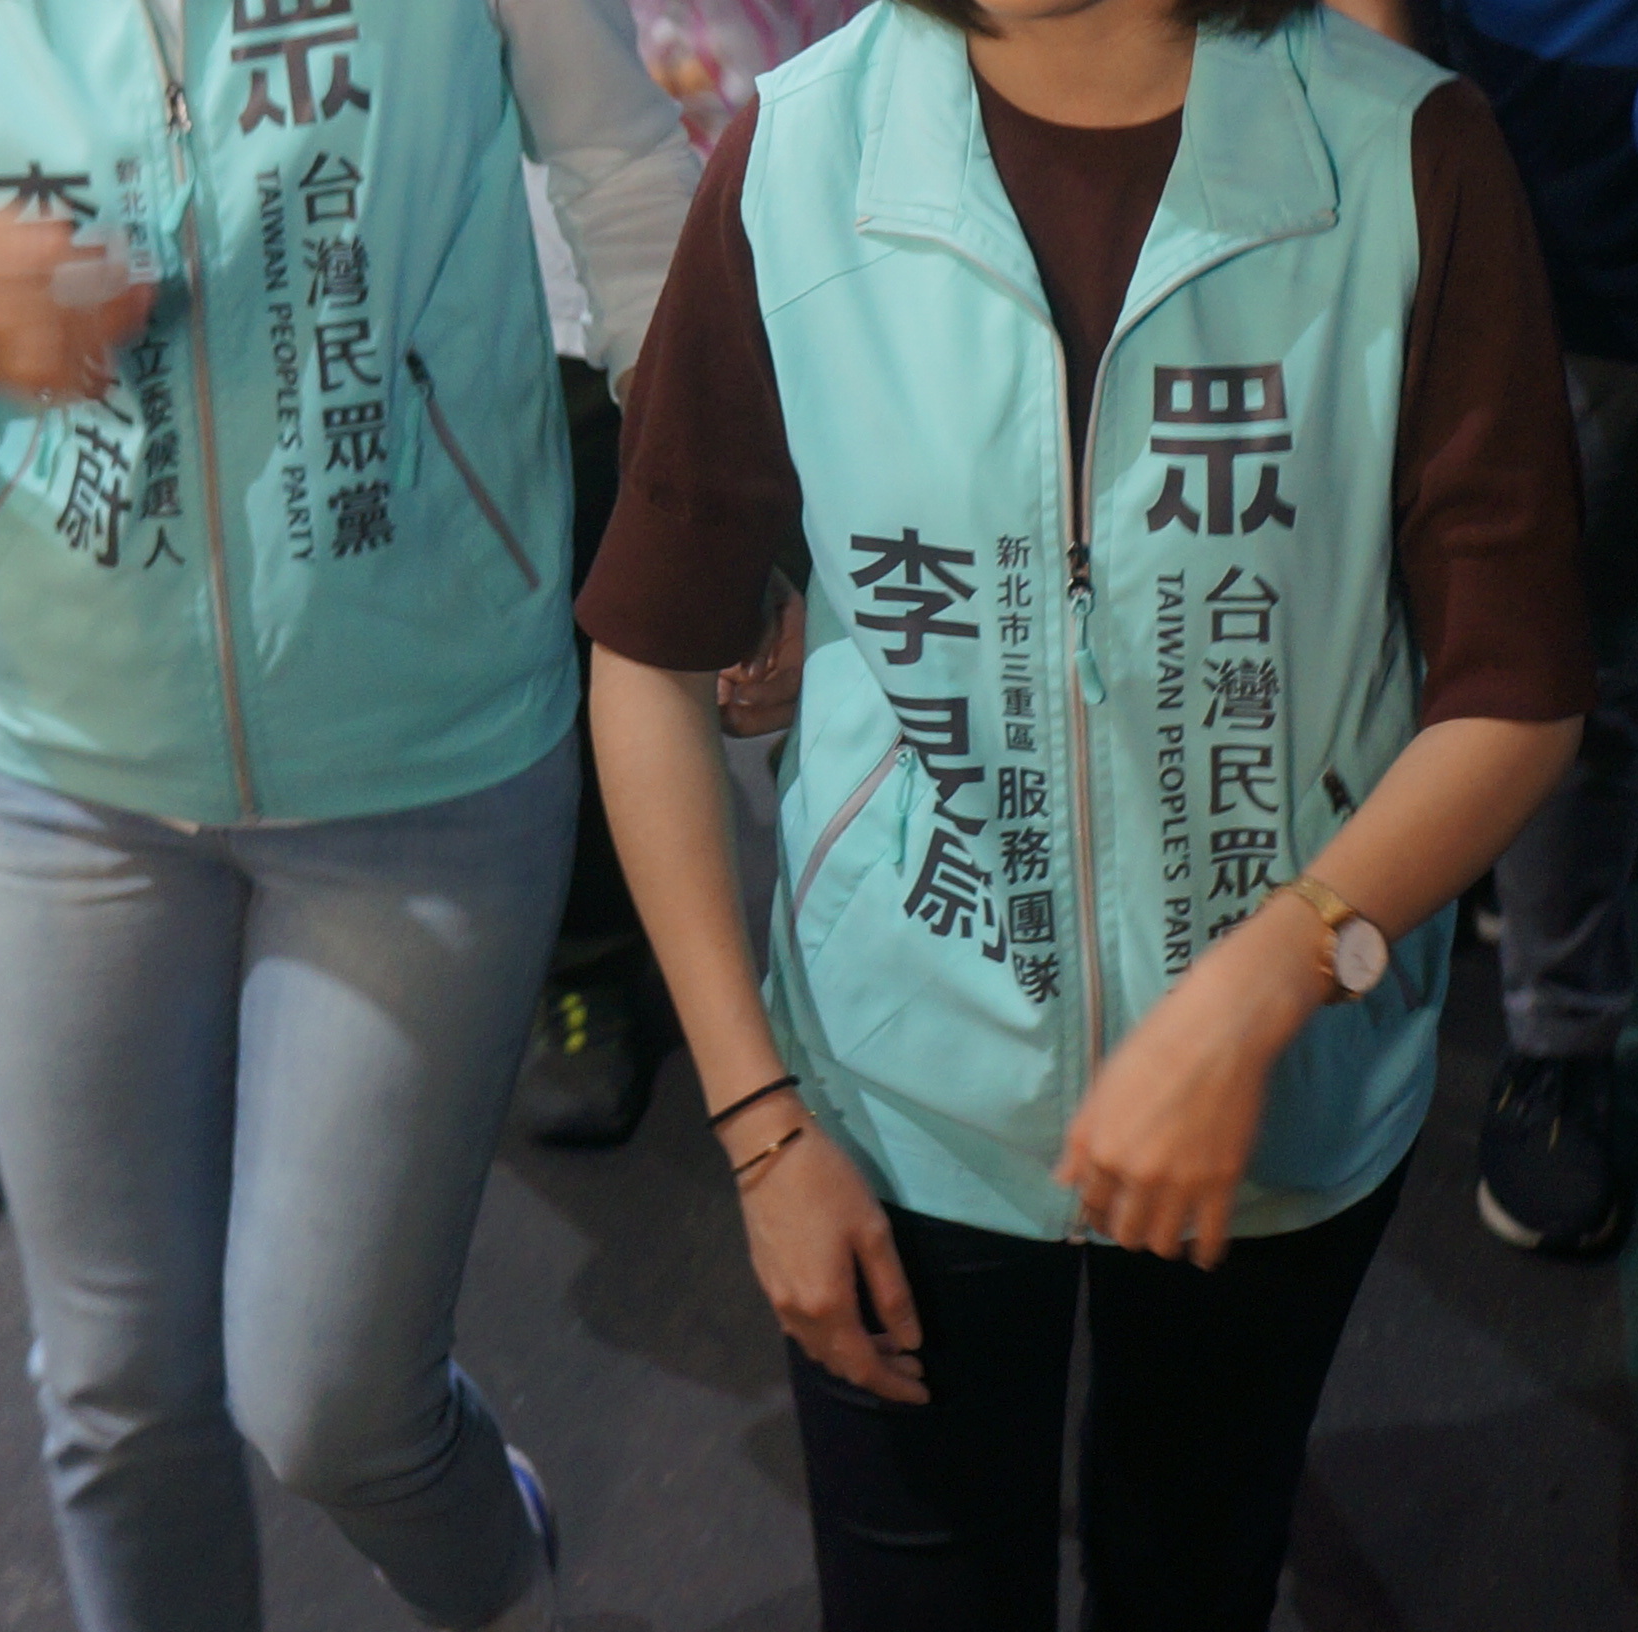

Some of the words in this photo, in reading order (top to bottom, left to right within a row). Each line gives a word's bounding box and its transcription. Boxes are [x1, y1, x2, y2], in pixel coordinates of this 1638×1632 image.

[256, 168, 289, 294] TAIWAN
[280, 464, 316, 563] PARTY
[297, 152, 395, 559] 台灣民眾黨
[1146, 362, 1297, 536] 眾
[1157, 570, 1185, 710] TAIWAN
[1158, 724, 1191, 882] PEOPLE'S
[1165, 896, 1193, 994] PART
